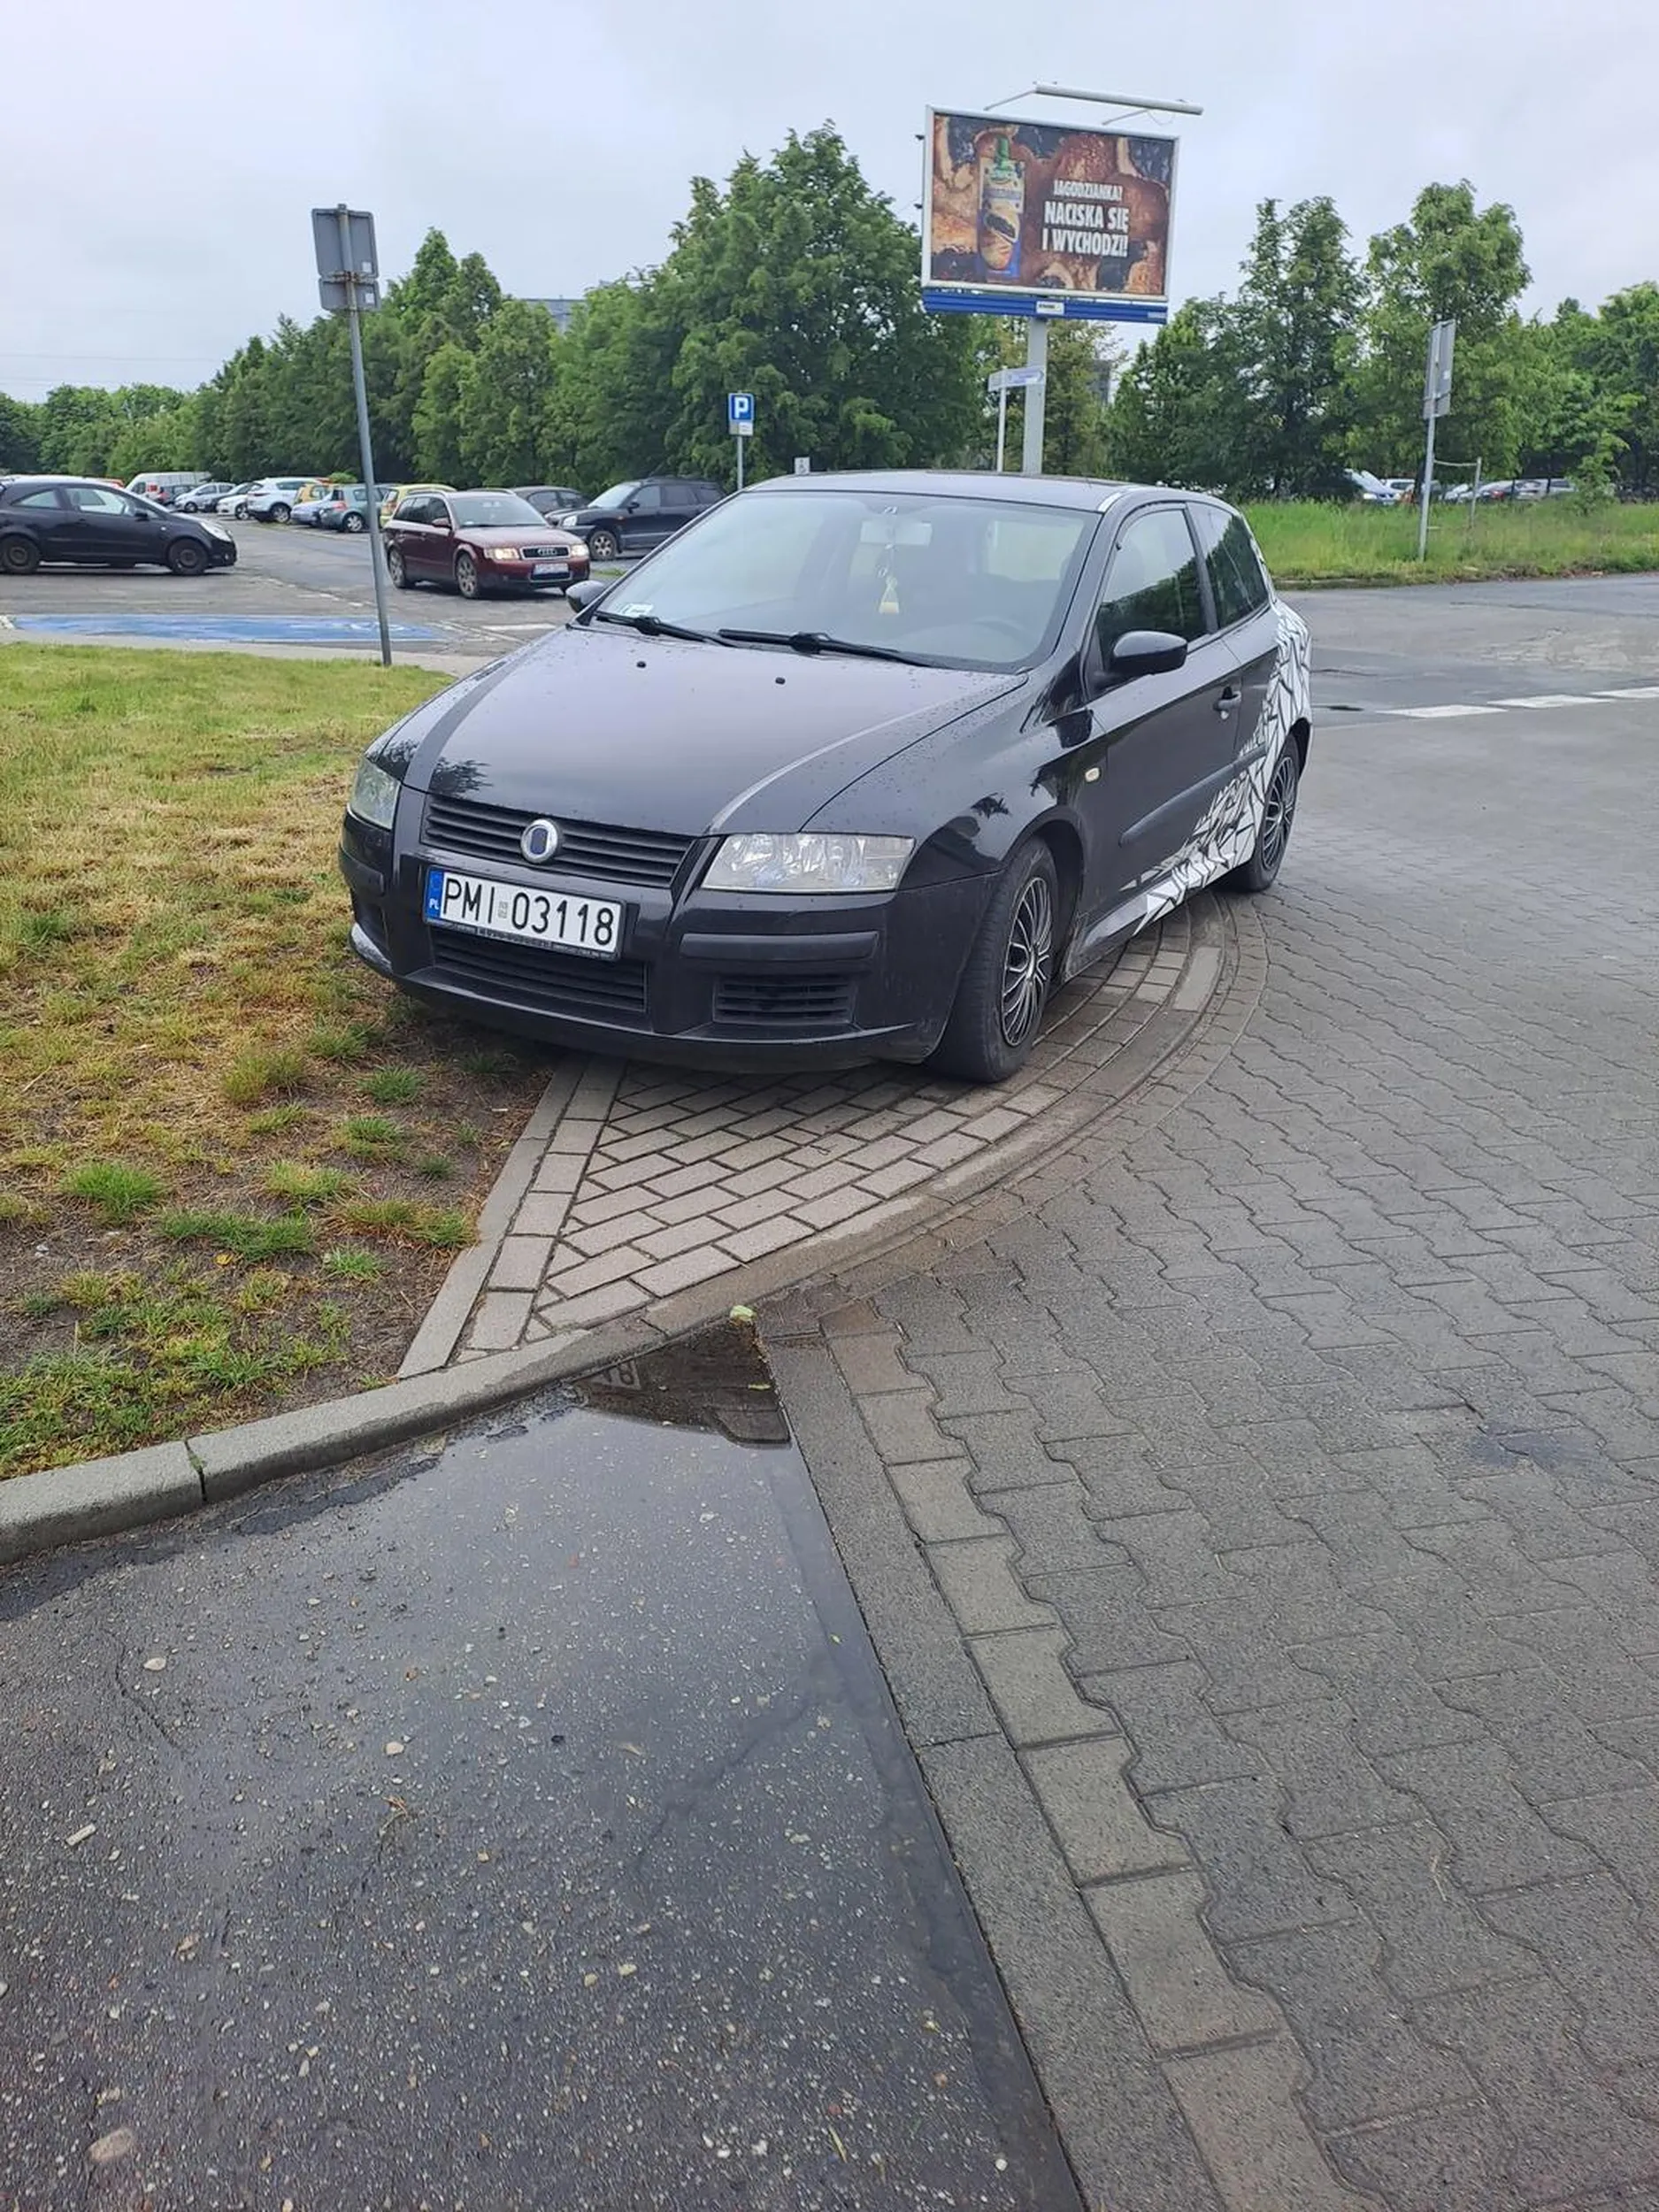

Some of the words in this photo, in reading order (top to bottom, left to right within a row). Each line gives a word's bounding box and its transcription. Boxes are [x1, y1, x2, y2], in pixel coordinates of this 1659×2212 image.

[1044, 201, 1104, 228] NACISKA
[1107, 206, 1130, 234] SIĘ
[1042, 227, 1048, 251] I
[1052, 228, 1129, 257] WYCHODZI!
[734, 397, 749, 419] P
[429, 898, 439, 910] PL
[443, 878, 495, 925] PMI
[511, 892, 614, 946] 03118
